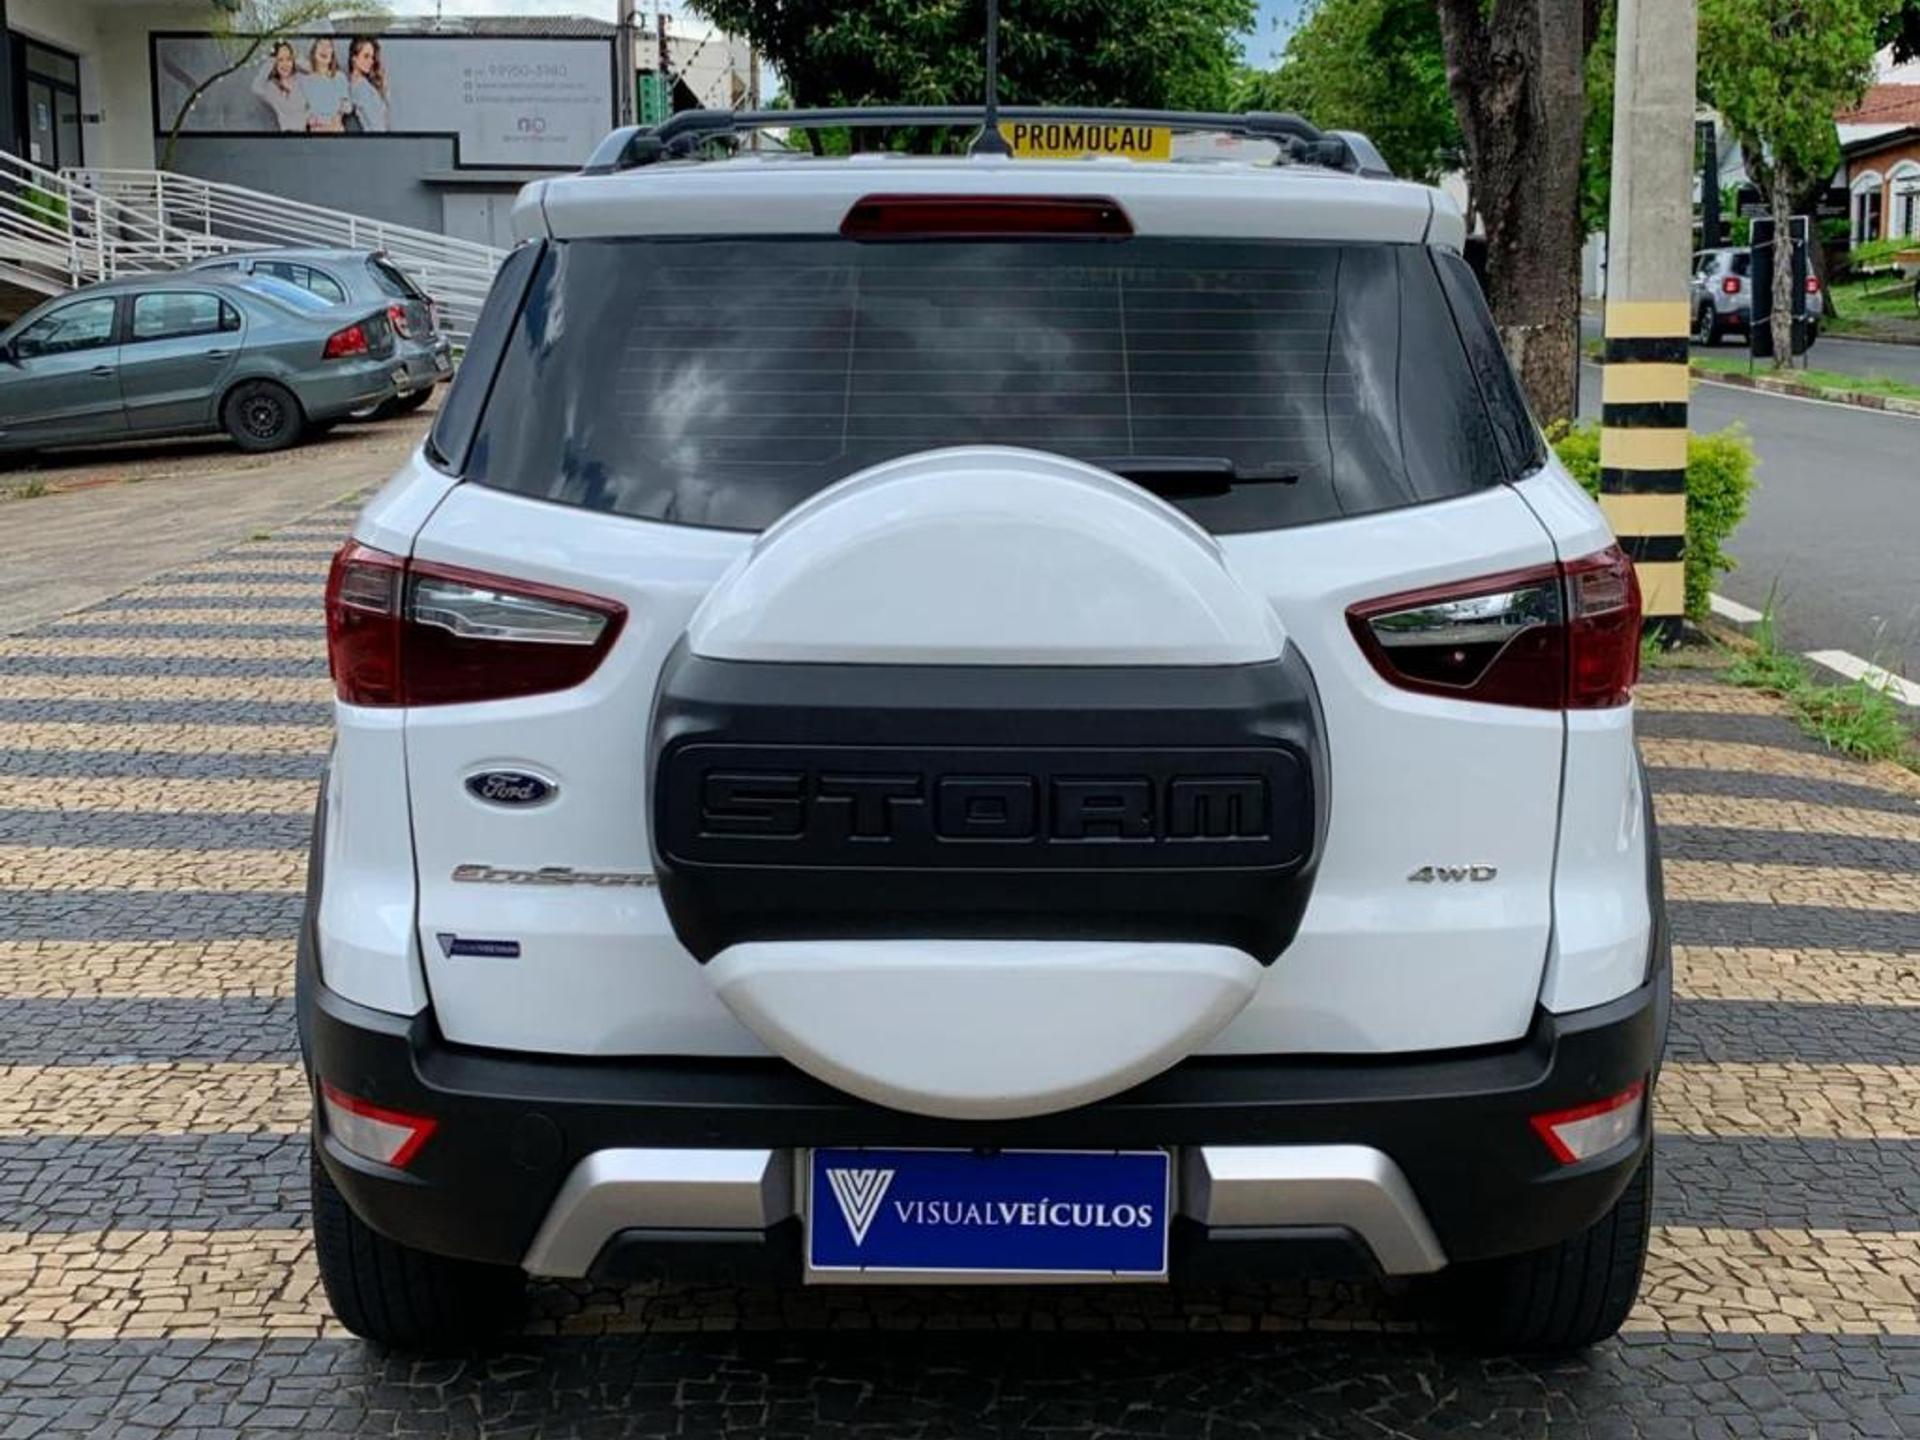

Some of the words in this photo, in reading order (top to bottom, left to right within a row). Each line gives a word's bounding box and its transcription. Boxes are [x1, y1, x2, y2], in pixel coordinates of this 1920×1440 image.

[482, 774, 534, 800] Ford
[697, 769, 1272, 844] STORM
[1406, 865, 1498, 884] 4WD
